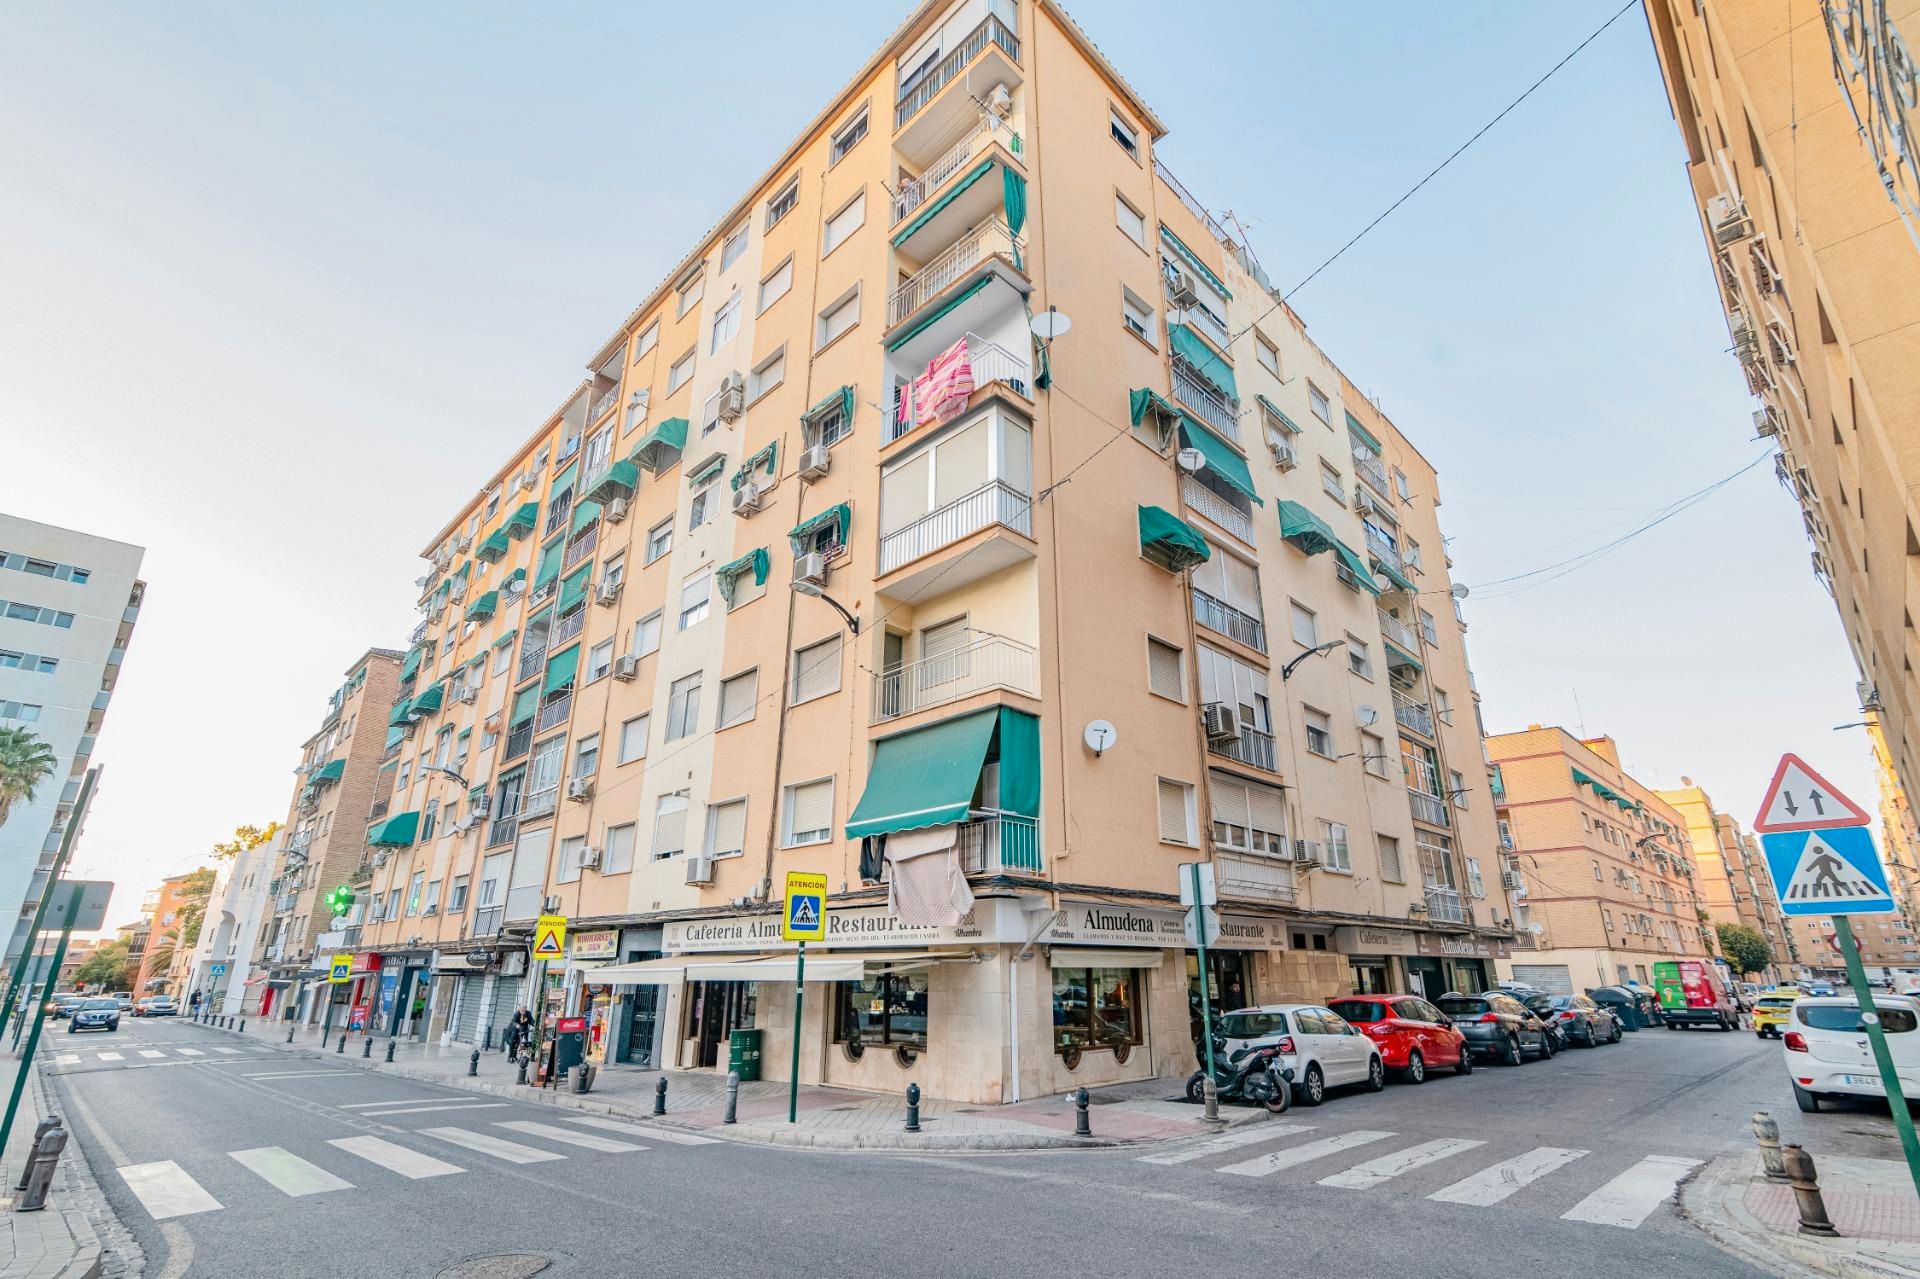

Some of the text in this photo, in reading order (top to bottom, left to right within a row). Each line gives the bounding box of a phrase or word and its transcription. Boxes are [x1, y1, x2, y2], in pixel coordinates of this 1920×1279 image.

[1084, 909, 1154, 933] Almudena
[686, 922, 742, 941] Cafetería
[954, 928, 983, 938] Alhambra
[1050, 929, 1075, 939] Alhambra
[1220, 922, 1265, 938] staurante
